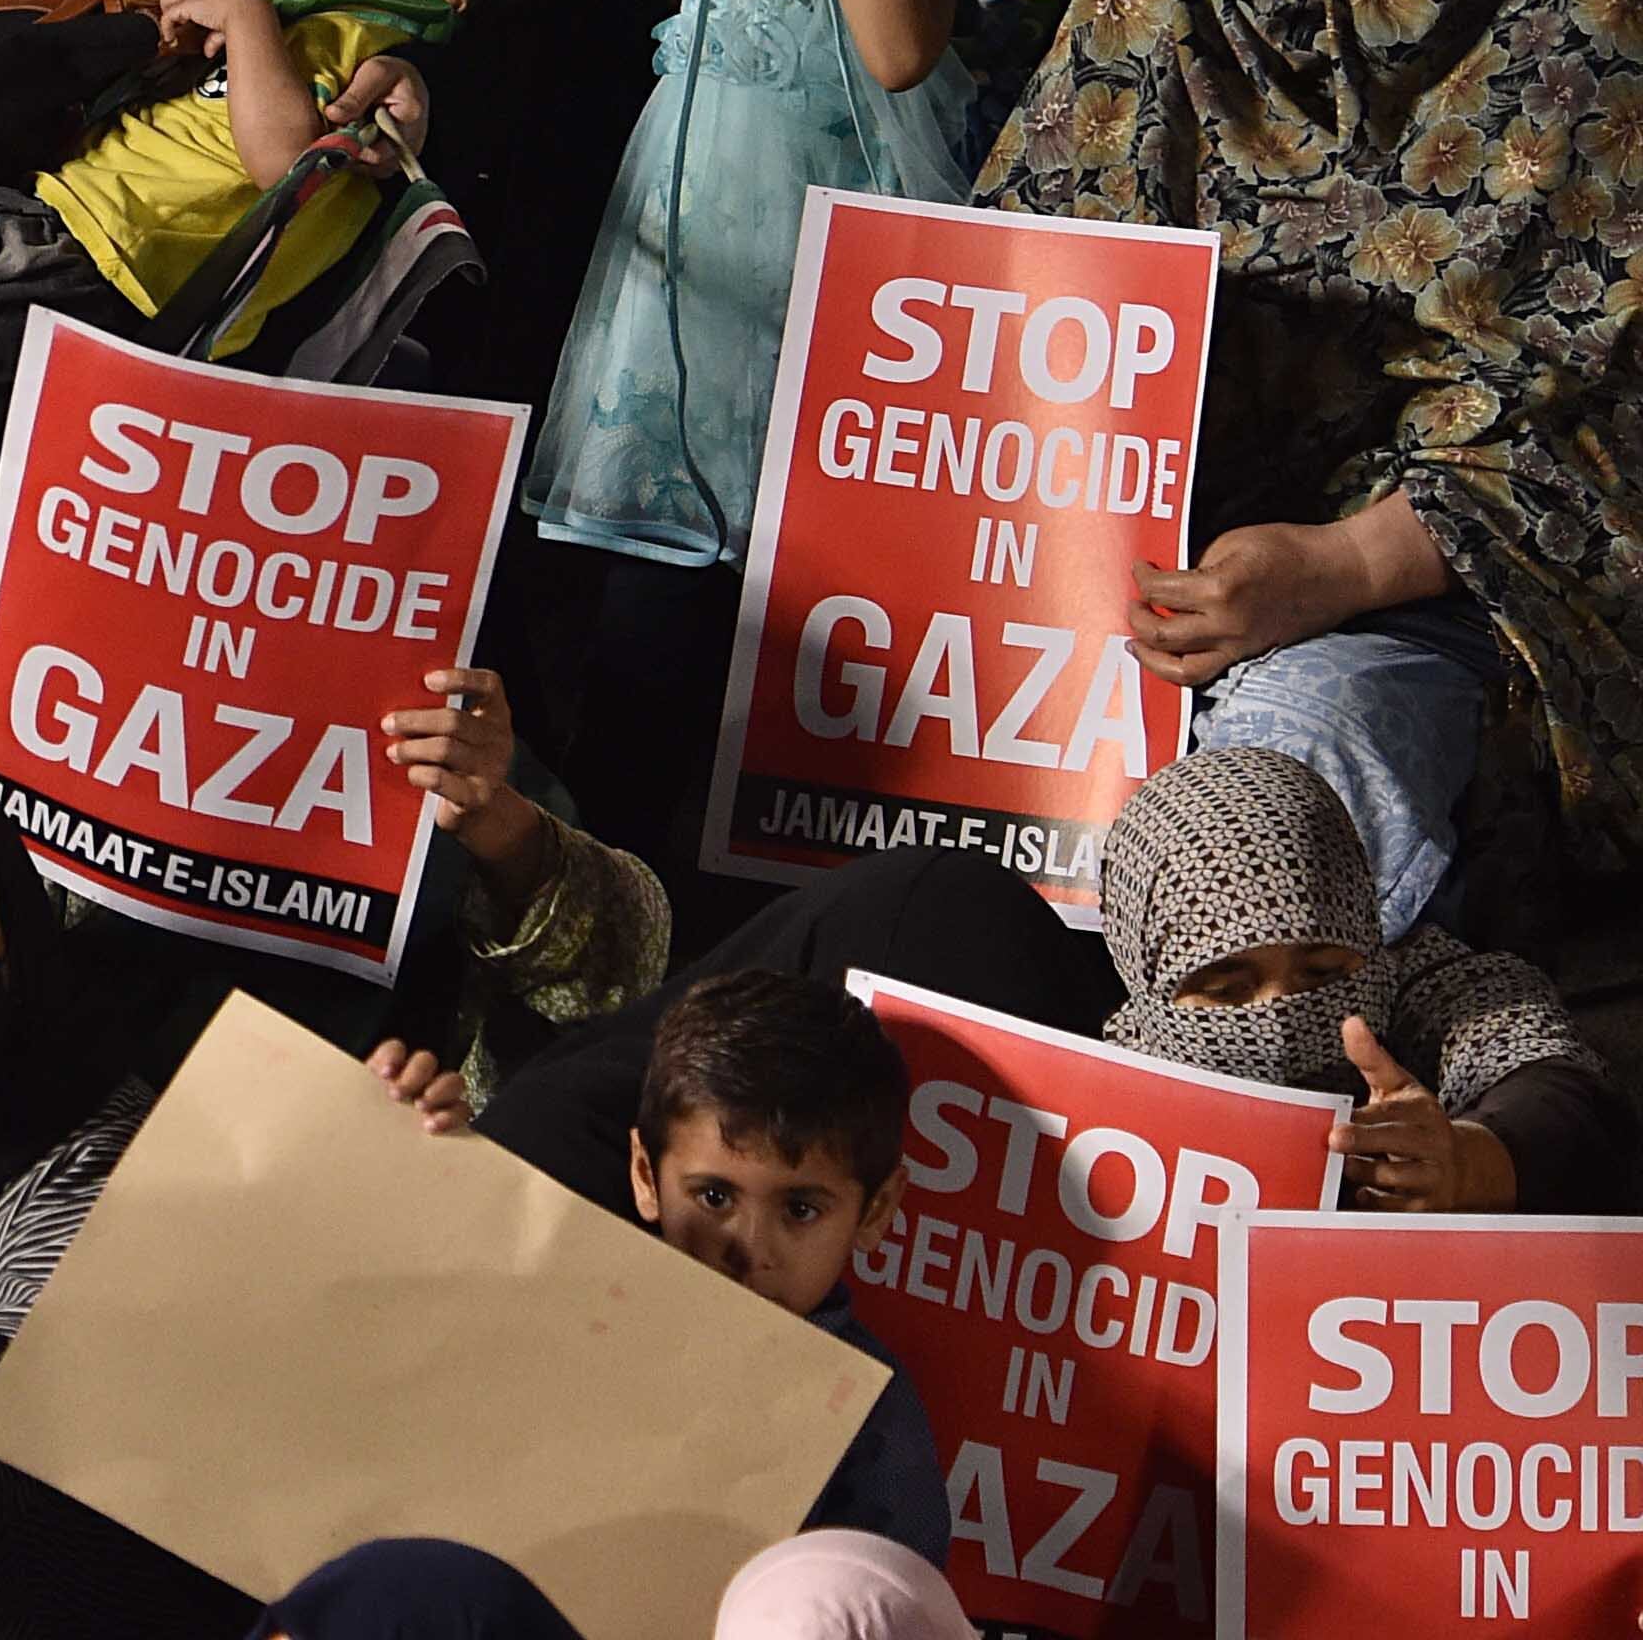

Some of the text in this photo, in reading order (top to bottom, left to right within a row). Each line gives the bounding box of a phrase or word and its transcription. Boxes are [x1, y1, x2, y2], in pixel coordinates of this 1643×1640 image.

[861, 276, 1176, 409] STOP
[80, 402, 440, 546] STOP
[818, 398, 1181, 520] GENOCIDE
[36, 485, 449, 642] GENOCIDE
[969, 517, 1040, 588] IN
[182, 614, 257, 680] IN
[792, 594, 1149, 780] GAZA
[9, 643, 374, 847] GAZA
[759, 789, 1107, 880] JAMAAT-E-ISLA
[901, 1079, 1261, 1261] STOP
[852, 1207, 1216, 1368] GENOCID
[1002, 1346, 1076, 1427] IN
[946, 1439, 1209, 1624] AZA
[1274, 1437, 1643, 1534] GENOCID
[1460, 1548, 1530, 1620] IN
